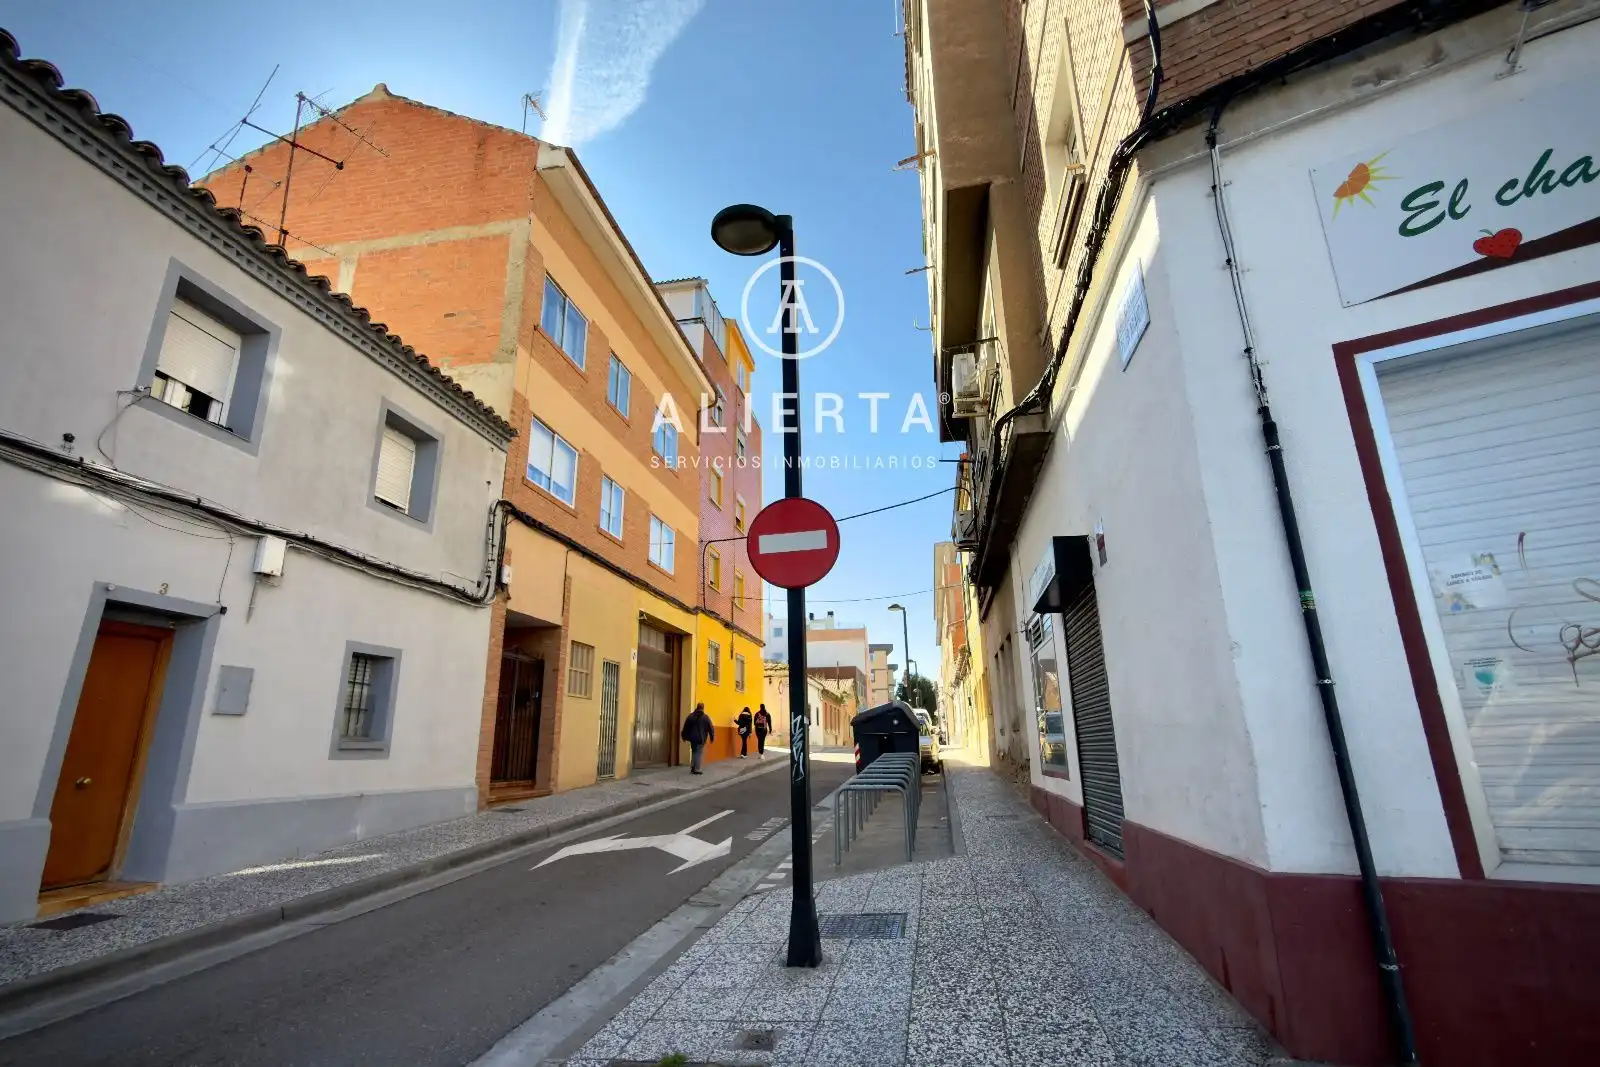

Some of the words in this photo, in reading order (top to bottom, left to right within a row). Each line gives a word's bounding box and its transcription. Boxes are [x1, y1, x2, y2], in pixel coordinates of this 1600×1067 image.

[1398, 177, 1471, 238] El
[1495, 148, 1600, 207] cha
[158, 582, 169, 595] 3
